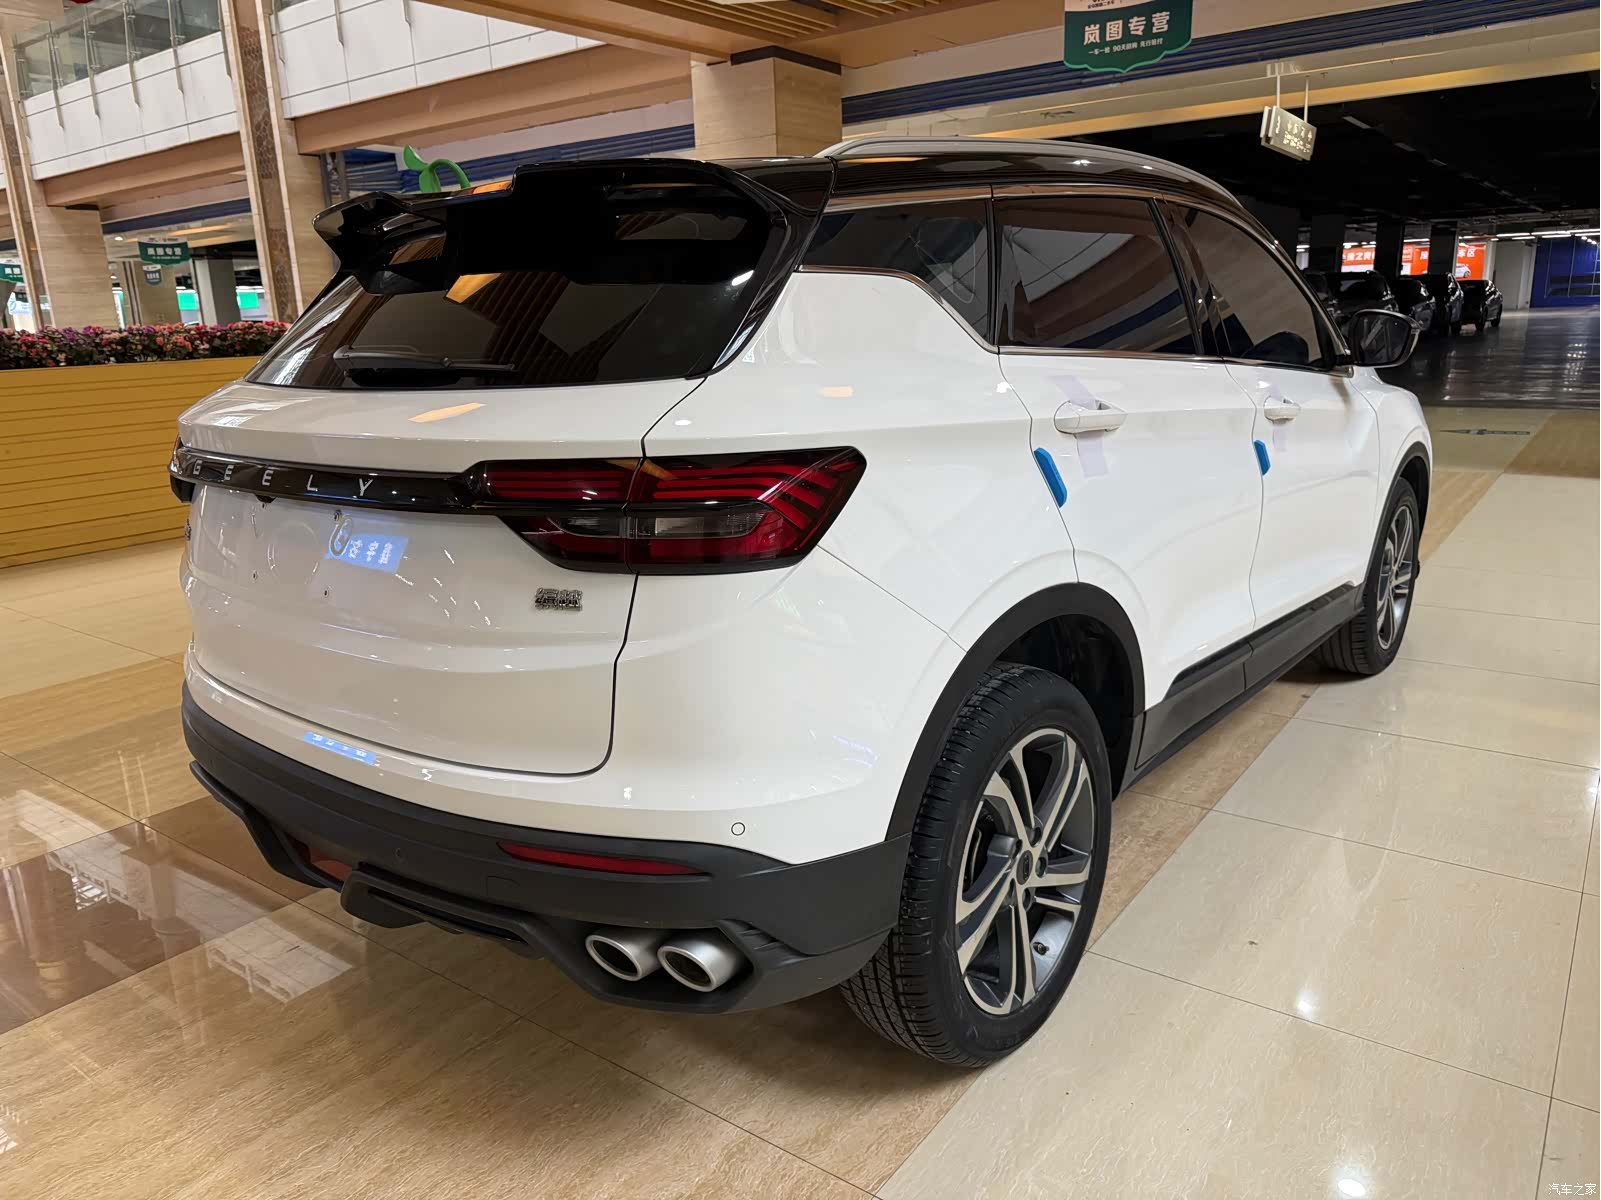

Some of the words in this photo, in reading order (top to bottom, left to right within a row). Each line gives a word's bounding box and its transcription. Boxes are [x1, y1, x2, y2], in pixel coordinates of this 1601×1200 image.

[1083, 11, 1170, 46] 岚图专营
[192, 459, 374, 497] GEELY
